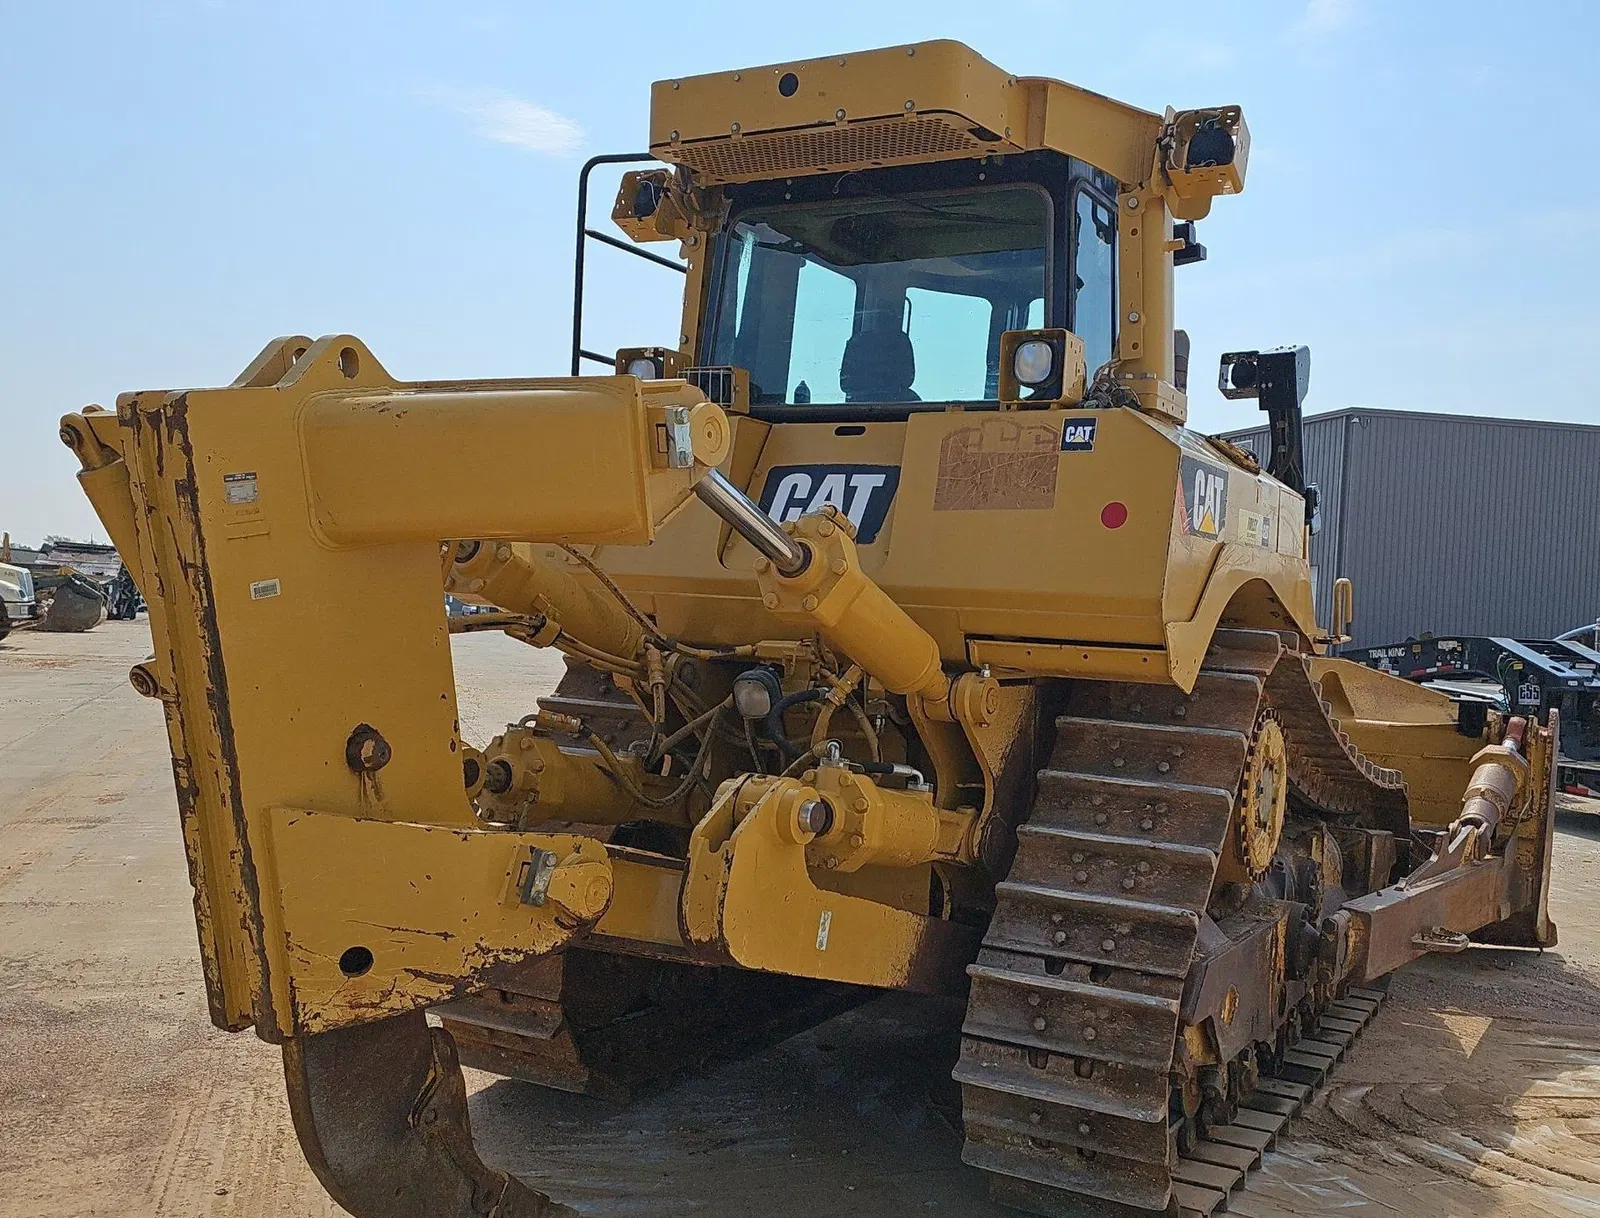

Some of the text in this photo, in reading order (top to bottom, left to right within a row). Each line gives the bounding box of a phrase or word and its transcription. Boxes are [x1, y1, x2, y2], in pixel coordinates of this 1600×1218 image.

[1065, 426, 1093, 442] CAT
[768, 473, 886, 529] CAT
[1193, 469, 1224, 535] CAT
[1368, 647, 1406, 658] TRAIL KING
